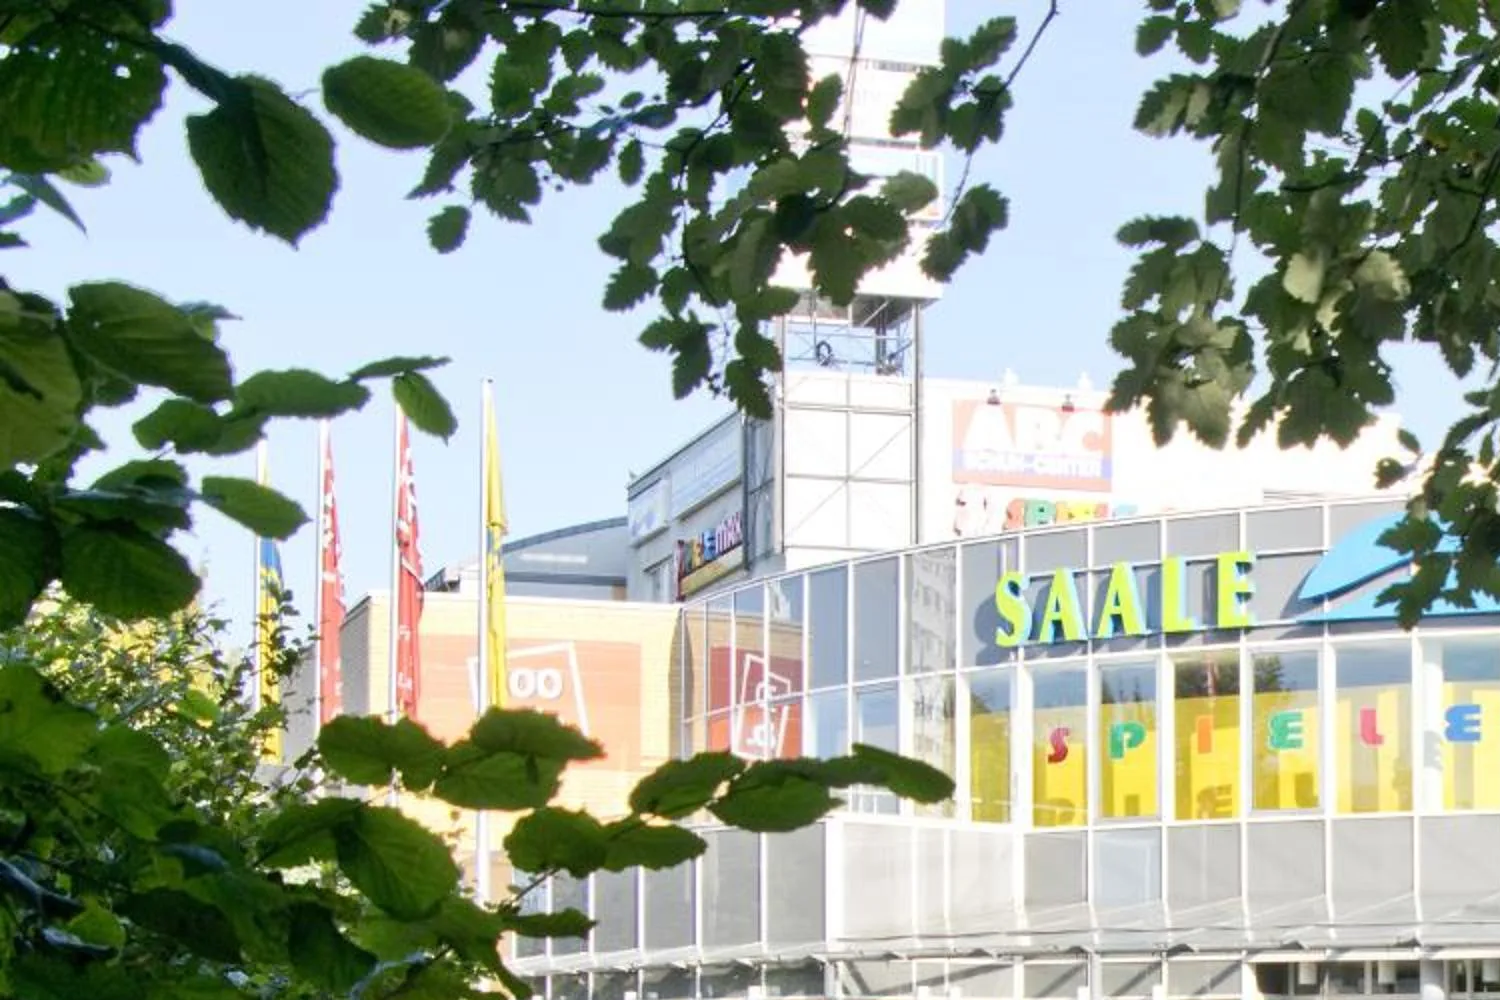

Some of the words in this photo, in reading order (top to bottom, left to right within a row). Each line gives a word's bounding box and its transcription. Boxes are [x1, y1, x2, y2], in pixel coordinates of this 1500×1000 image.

[963, 403, 1108, 455] ABC
[995, 550, 1257, 647] SAALE
[1047, 704, 1482, 764] SPIELE
